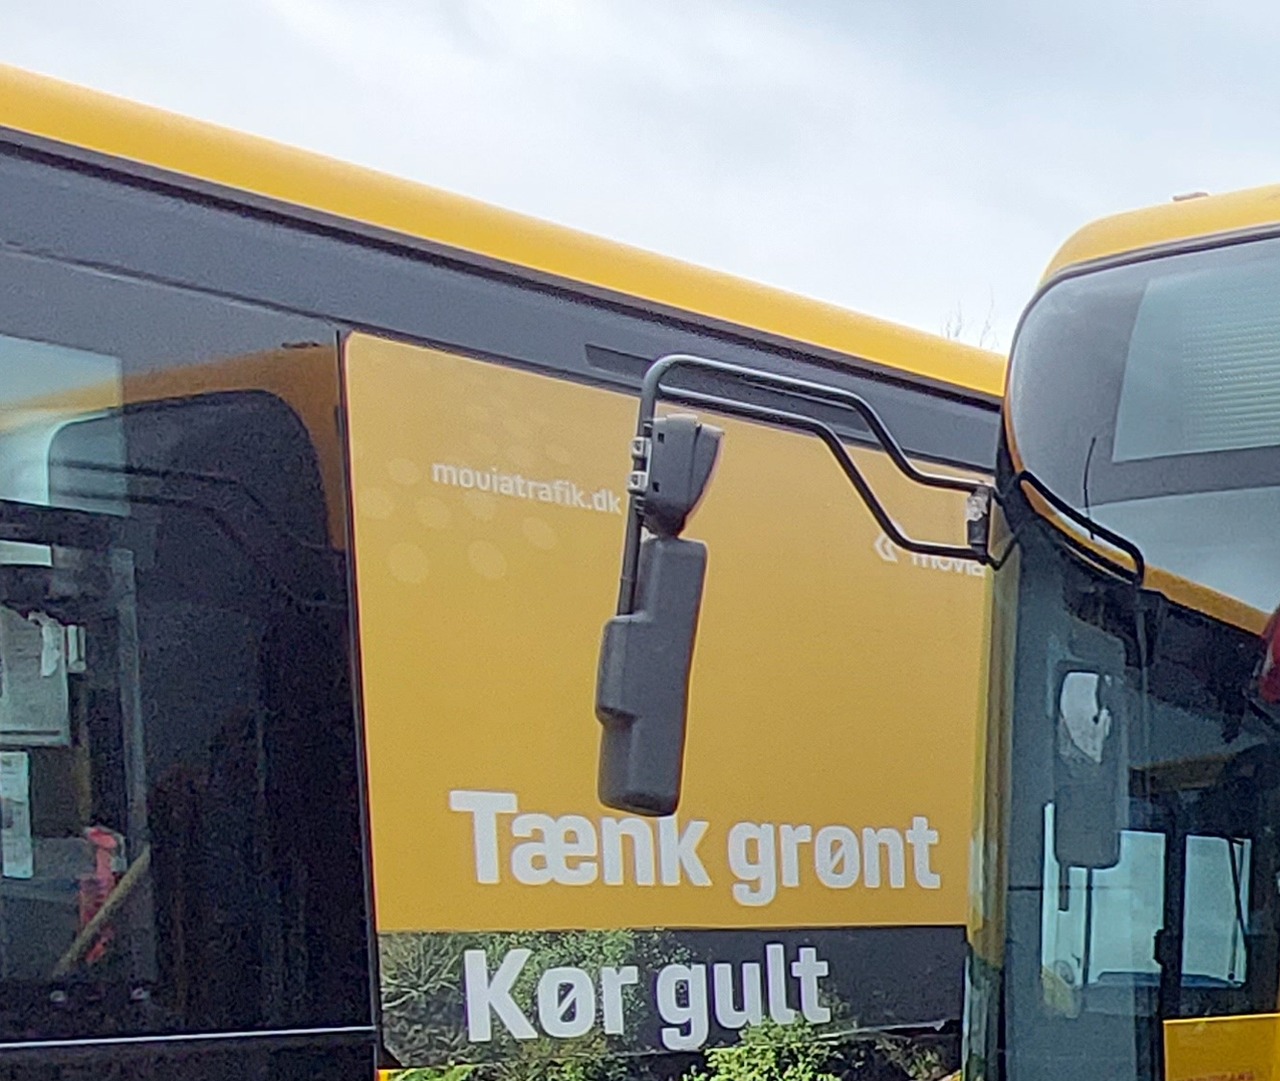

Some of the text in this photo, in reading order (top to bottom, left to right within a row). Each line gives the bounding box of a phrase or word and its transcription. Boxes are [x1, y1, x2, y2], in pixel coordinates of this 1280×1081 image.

[431, 461, 621, 514] moviatrafik.dk
[449, 790, 940, 908] Tænk grønt
[464, 944, 831, 1050] Kør gult
